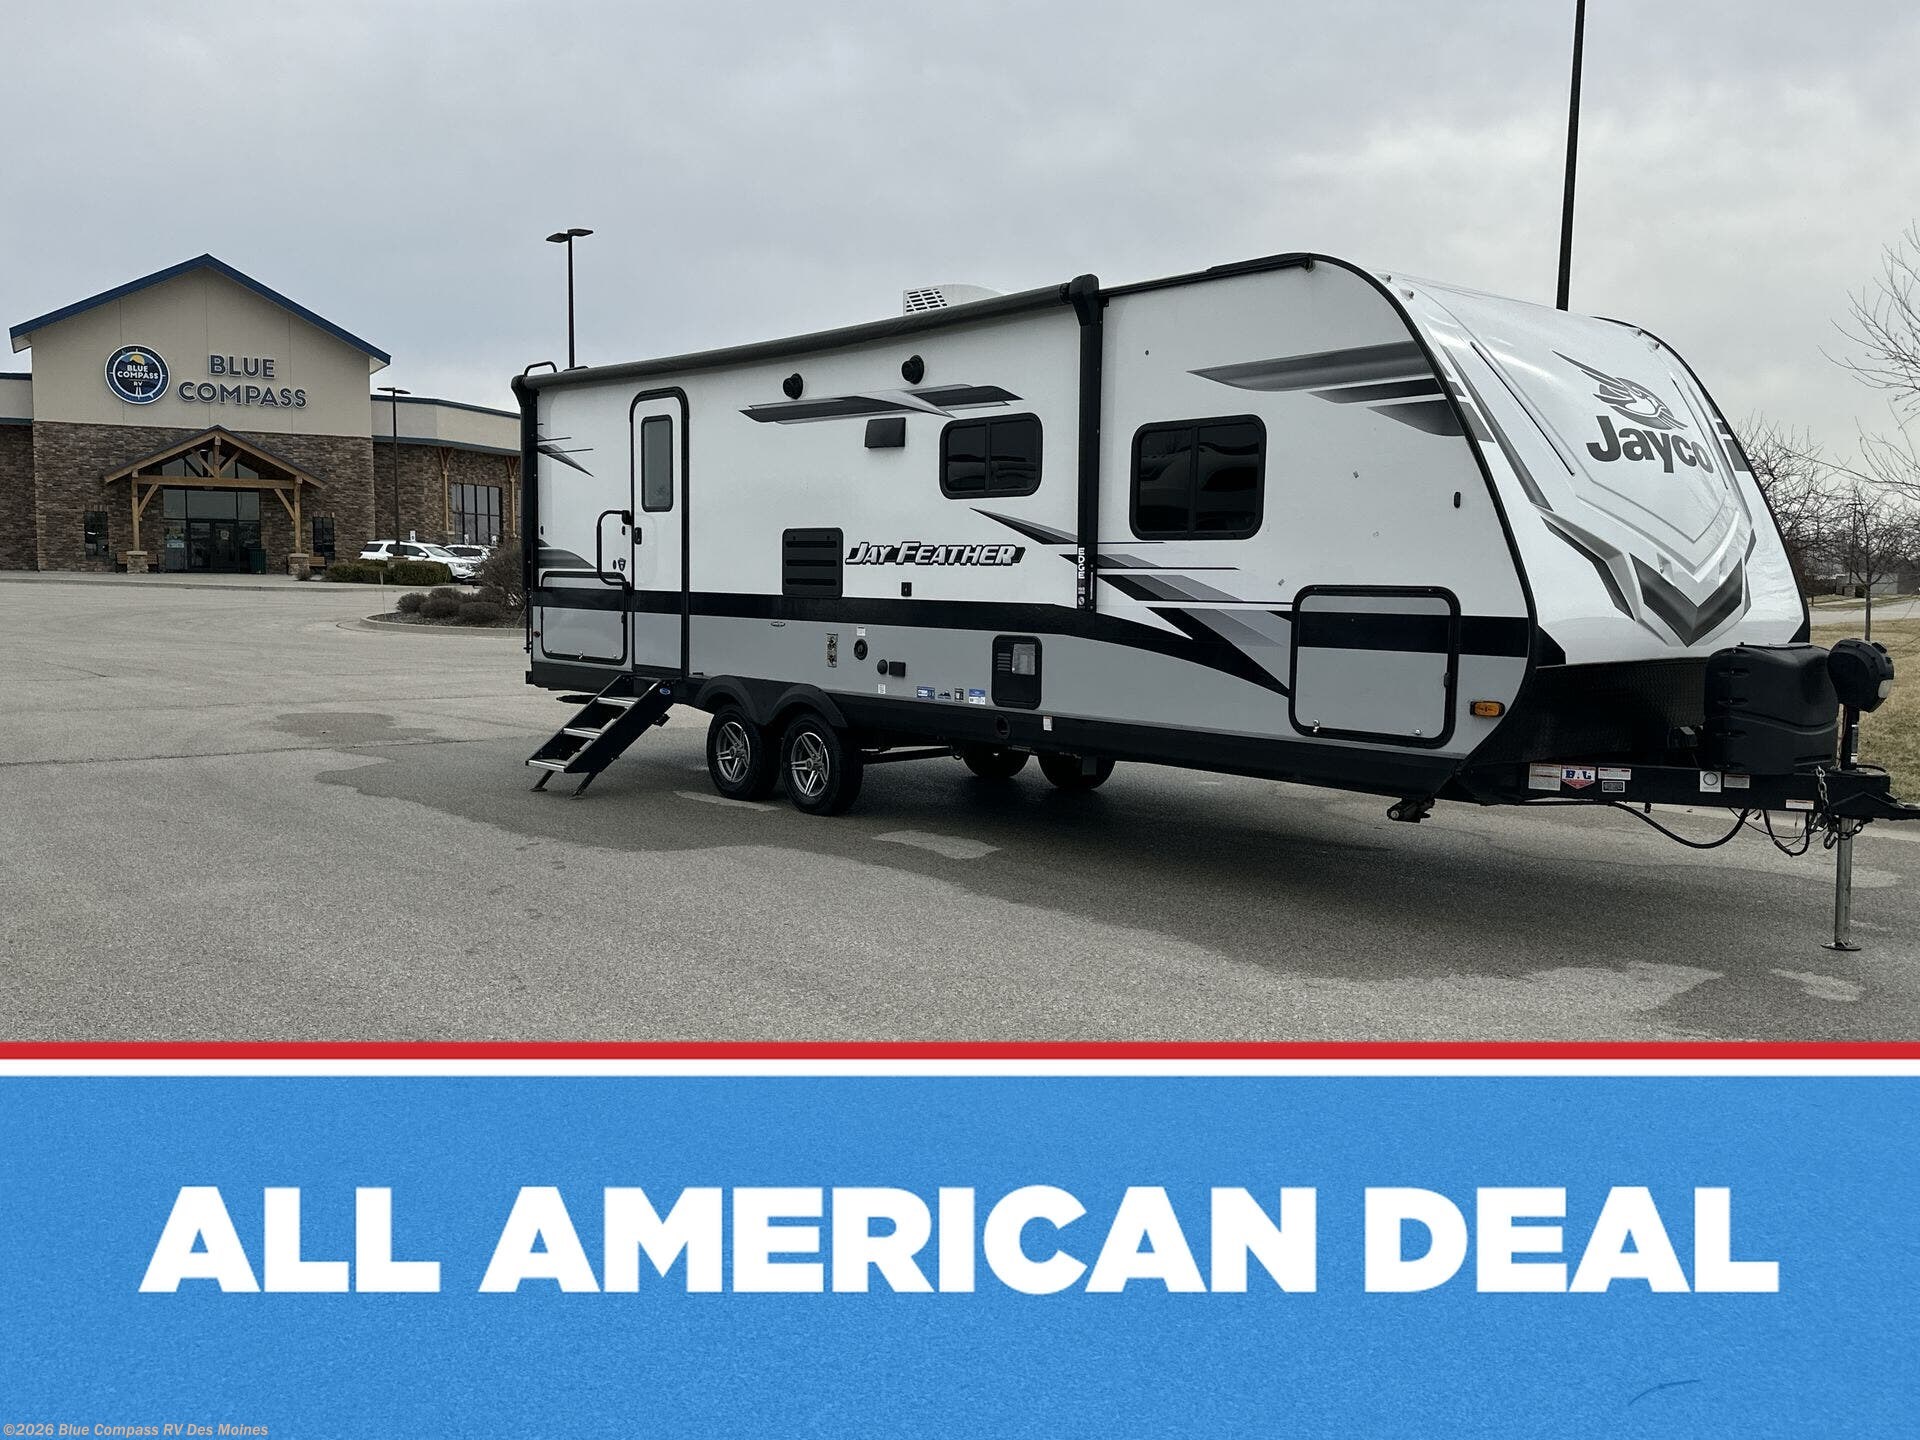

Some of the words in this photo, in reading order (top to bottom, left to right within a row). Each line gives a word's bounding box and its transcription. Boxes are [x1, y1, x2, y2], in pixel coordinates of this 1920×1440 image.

[117, 370, 159, 380] COMPASS
[127, 364, 148, 373] BLUE
[208, 354, 276, 379] BLUE
[178, 381, 307, 408] COMPASS
[1586, 415, 1714, 474] Jayco
[846, 542, 893, 565] JAY
[895, 541, 1018, 566] FEATHER
